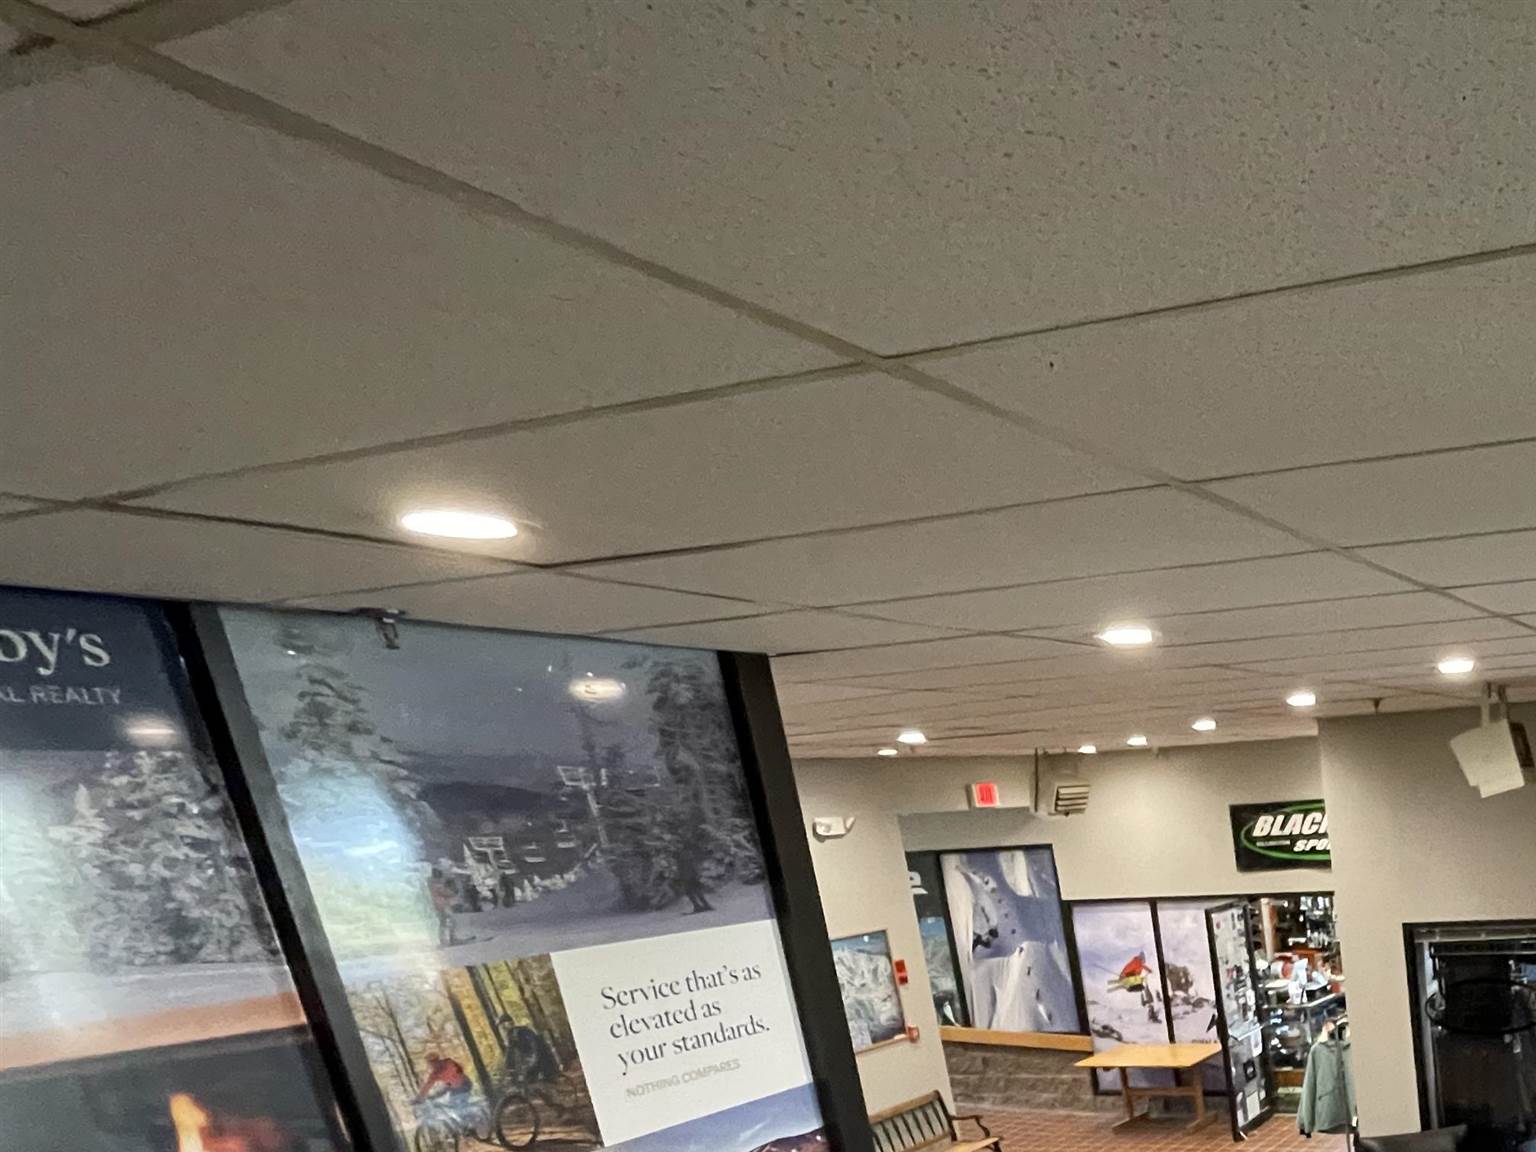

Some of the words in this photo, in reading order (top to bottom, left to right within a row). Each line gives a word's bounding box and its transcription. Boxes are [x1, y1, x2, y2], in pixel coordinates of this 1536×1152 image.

[29, 684, 120, 705] REALTY
[1293, 838, 1331, 852] SPO
[600, 978, 681, 1010] Service
[686, 964, 739, 993] that's
[743, 964, 762, 981] as
[609, 999, 698, 1039] elevated
[702, 998, 722, 1018] as
[617, 1041, 667, 1076] your
[673, 1014, 770, 1055] standards.
[626, 1074, 681, 1098] NOTHING
[682, 1058, 741, 1084] COMPARES
